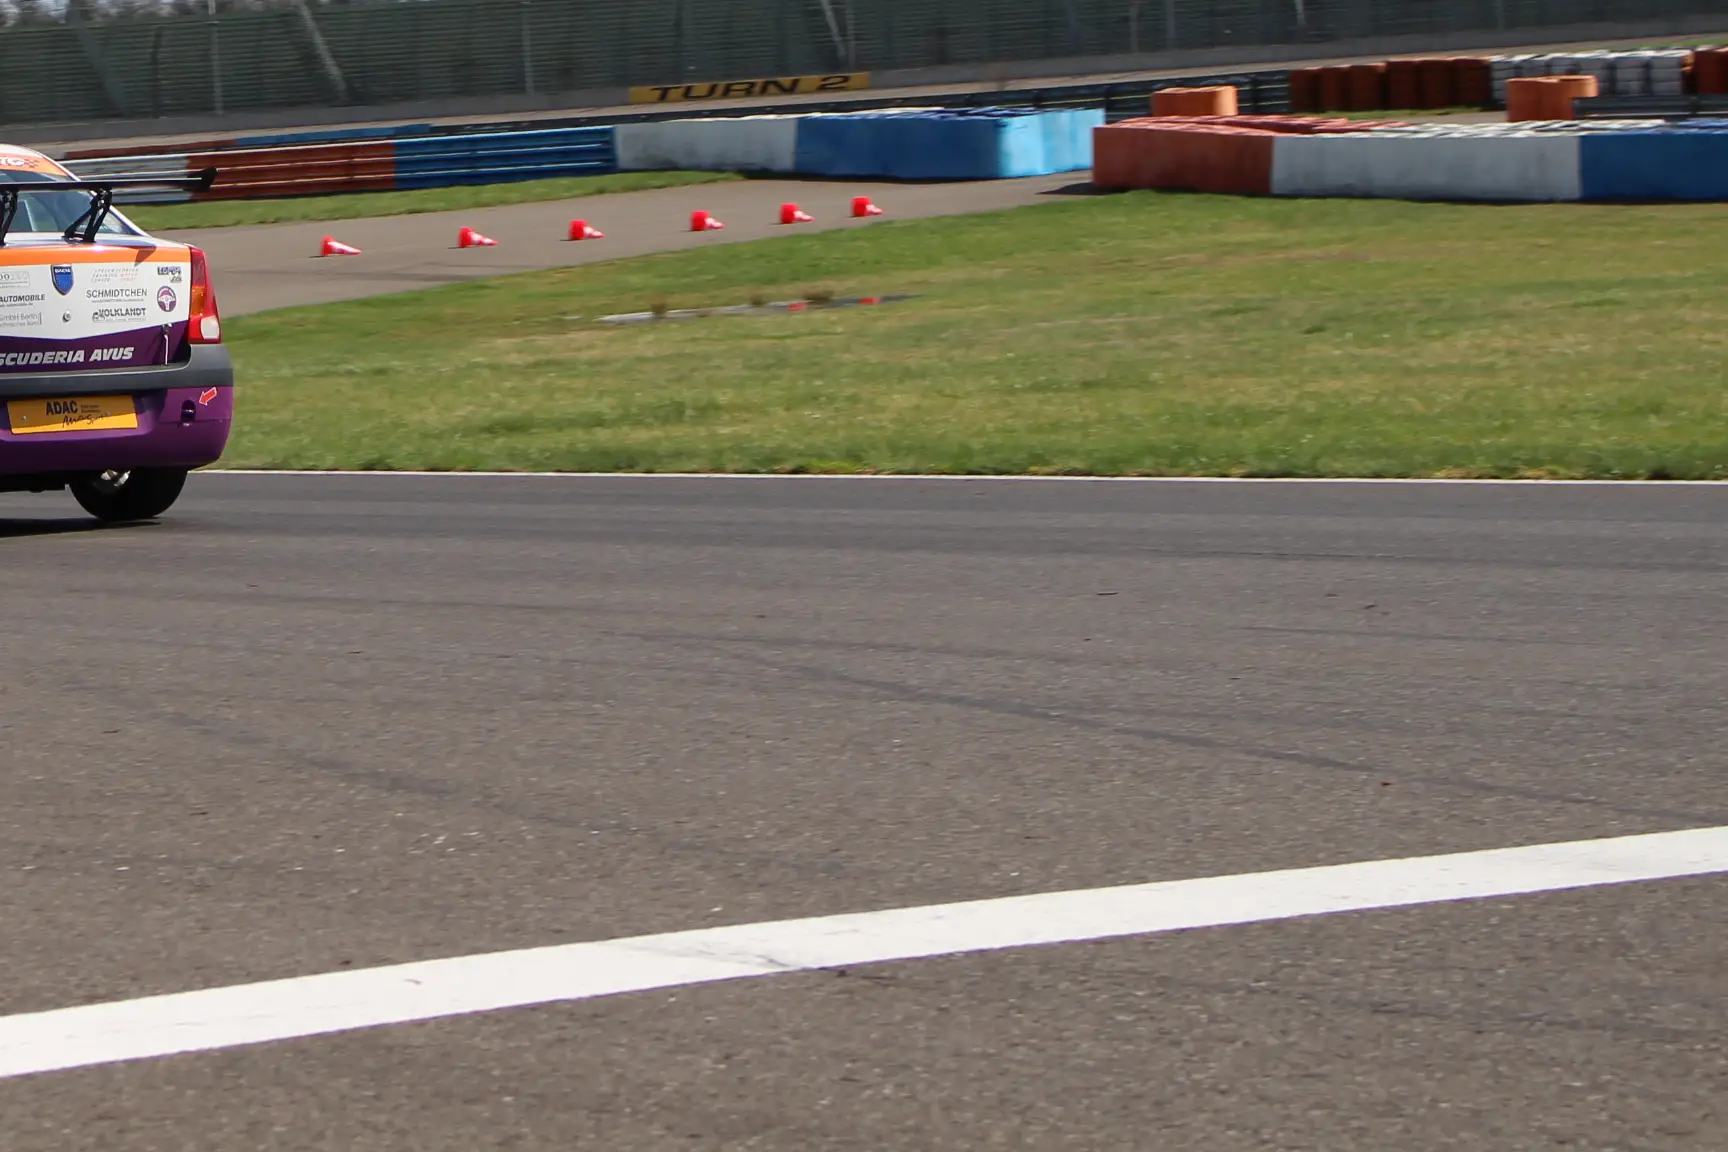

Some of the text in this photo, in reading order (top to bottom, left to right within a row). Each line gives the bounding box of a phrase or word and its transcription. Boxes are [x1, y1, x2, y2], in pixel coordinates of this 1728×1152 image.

[651, 75, 851, 101] TURN 2
[86, 288, 148, 298] SCHMIDTCHEN
[98, 308, 147, 317] VOLKLANDT
[89, 347, 135, 362] AVUS
[46, 401, 78, 415] ADAC
